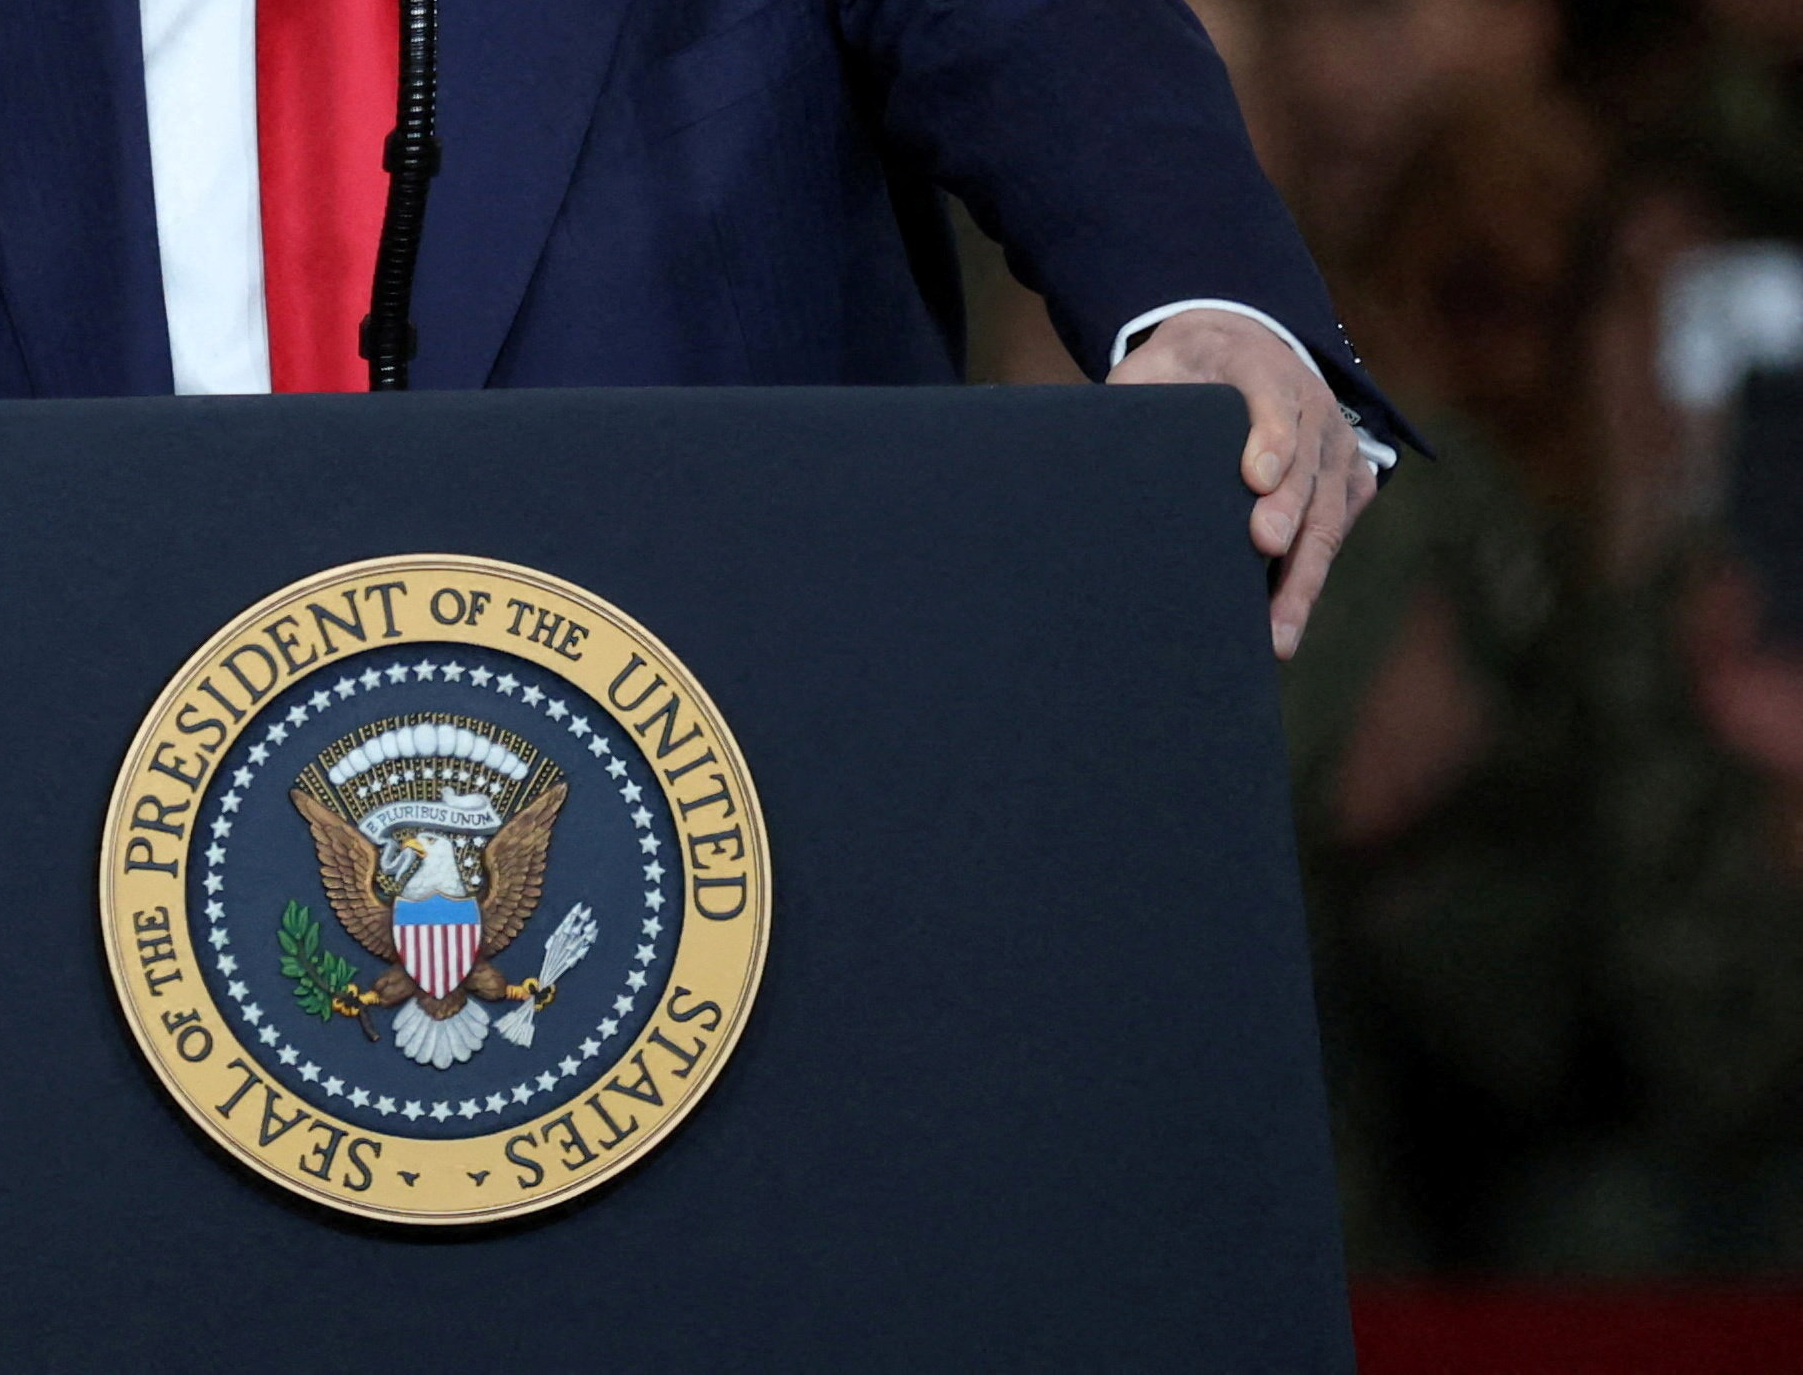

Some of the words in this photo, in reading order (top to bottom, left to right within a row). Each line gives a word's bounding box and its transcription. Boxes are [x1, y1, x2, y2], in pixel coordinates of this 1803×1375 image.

[430, 587, 492, 627] OF
[506, 597, 590, 662] THE
[123, 580, 408, 879] PRESIDENT
[376, 805, 448, 826] PLURIBUS
[450, 811, 494, 826] UNUM
[607, 651, 748, 922] UNITED
[132, 906, 183, 997] THE
[160, 1008, 214, 1063] OF
[214, 1057, 383, 1193] SEAL
[504, 985, 723, 1190] STATES
